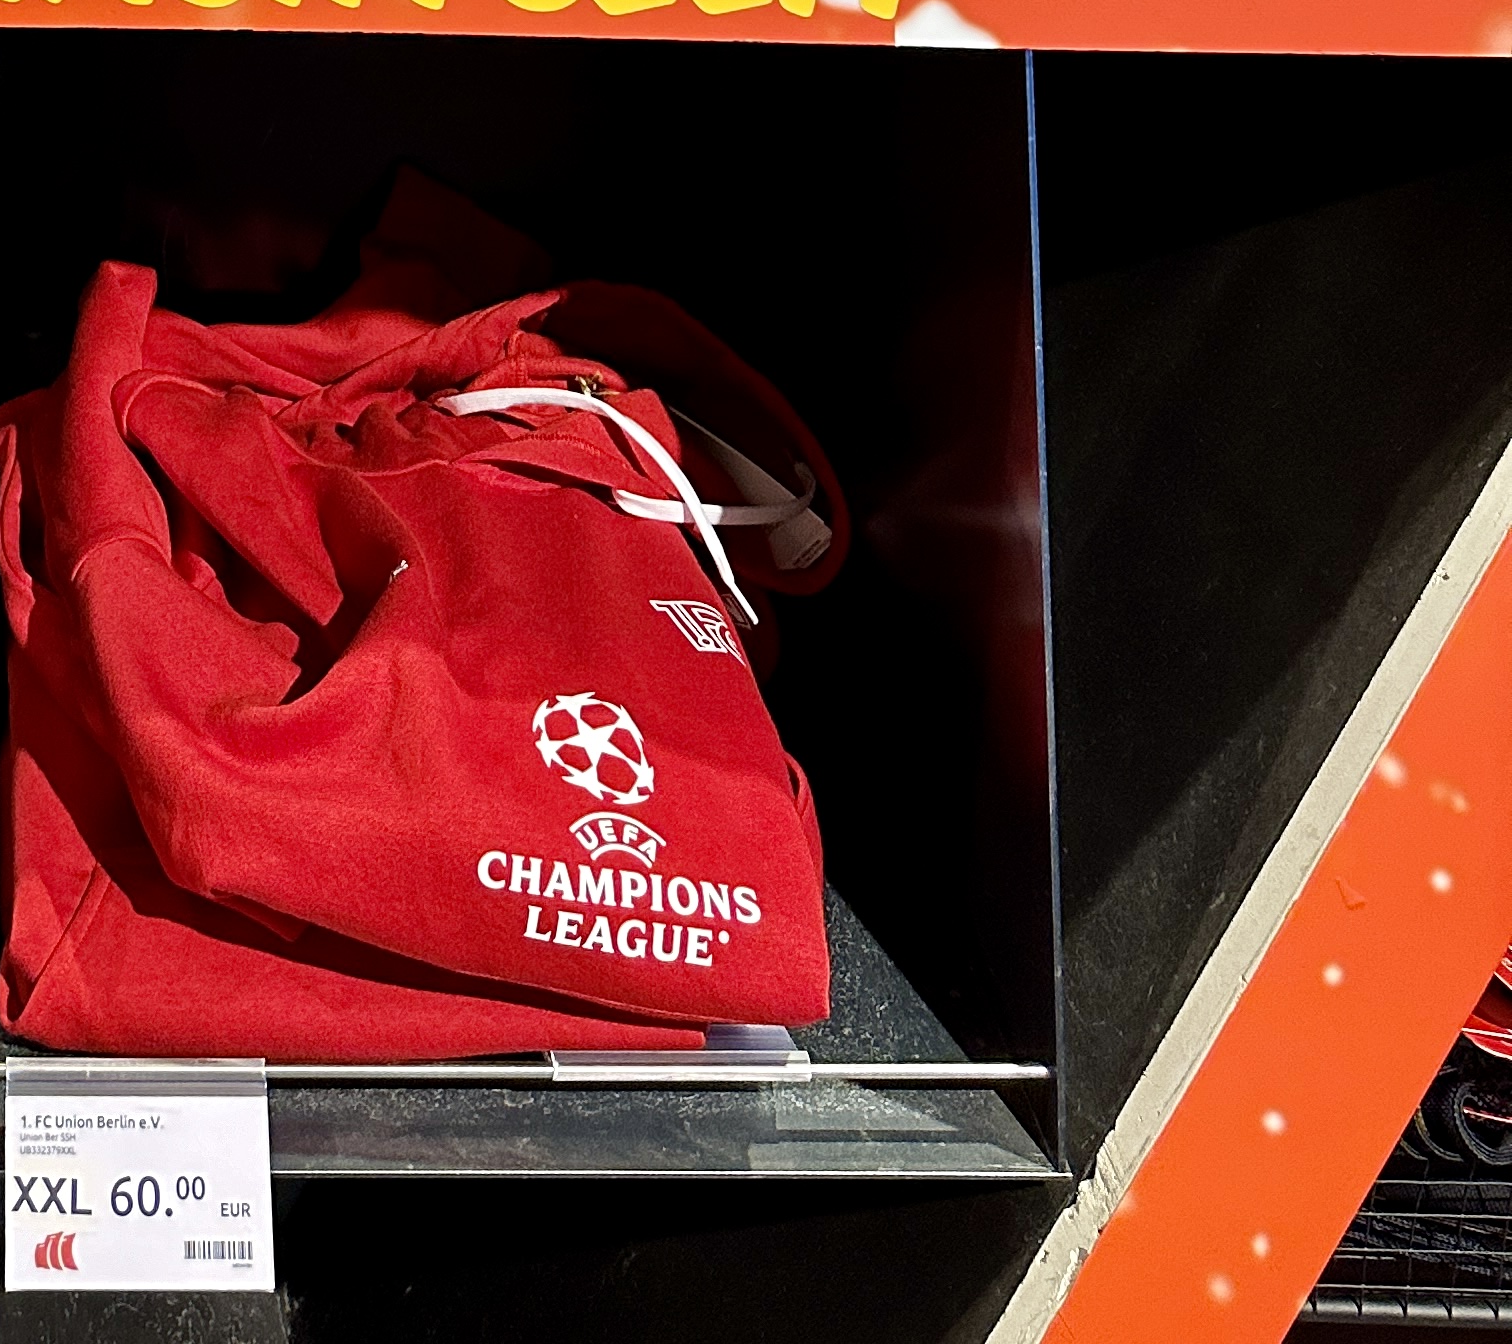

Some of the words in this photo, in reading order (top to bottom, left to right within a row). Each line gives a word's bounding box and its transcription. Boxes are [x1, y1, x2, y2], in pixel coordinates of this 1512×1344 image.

[576, 816, 658, 862] UEFA
[476, 851, 762, 925] CHAMPIONS
[524, 906, 714, 968] LEAGUE
[20, 1133, 43, 1142] Union
[60, 1133, 76, 1142] SSH
[21, 1116, 32, 1128] 1.
[35, 1115, 53, 1128] FC
[55, 1115, 93, 1129] Union
[97, 1116, 136, 1129] Berlin
[139, 1116, 164, 1129] e.V.
[11, 1176, 92, 1215] XXL
[110, 1175, 205, 1217] 60.00
[220, 1202, 251, 1217] EUR
